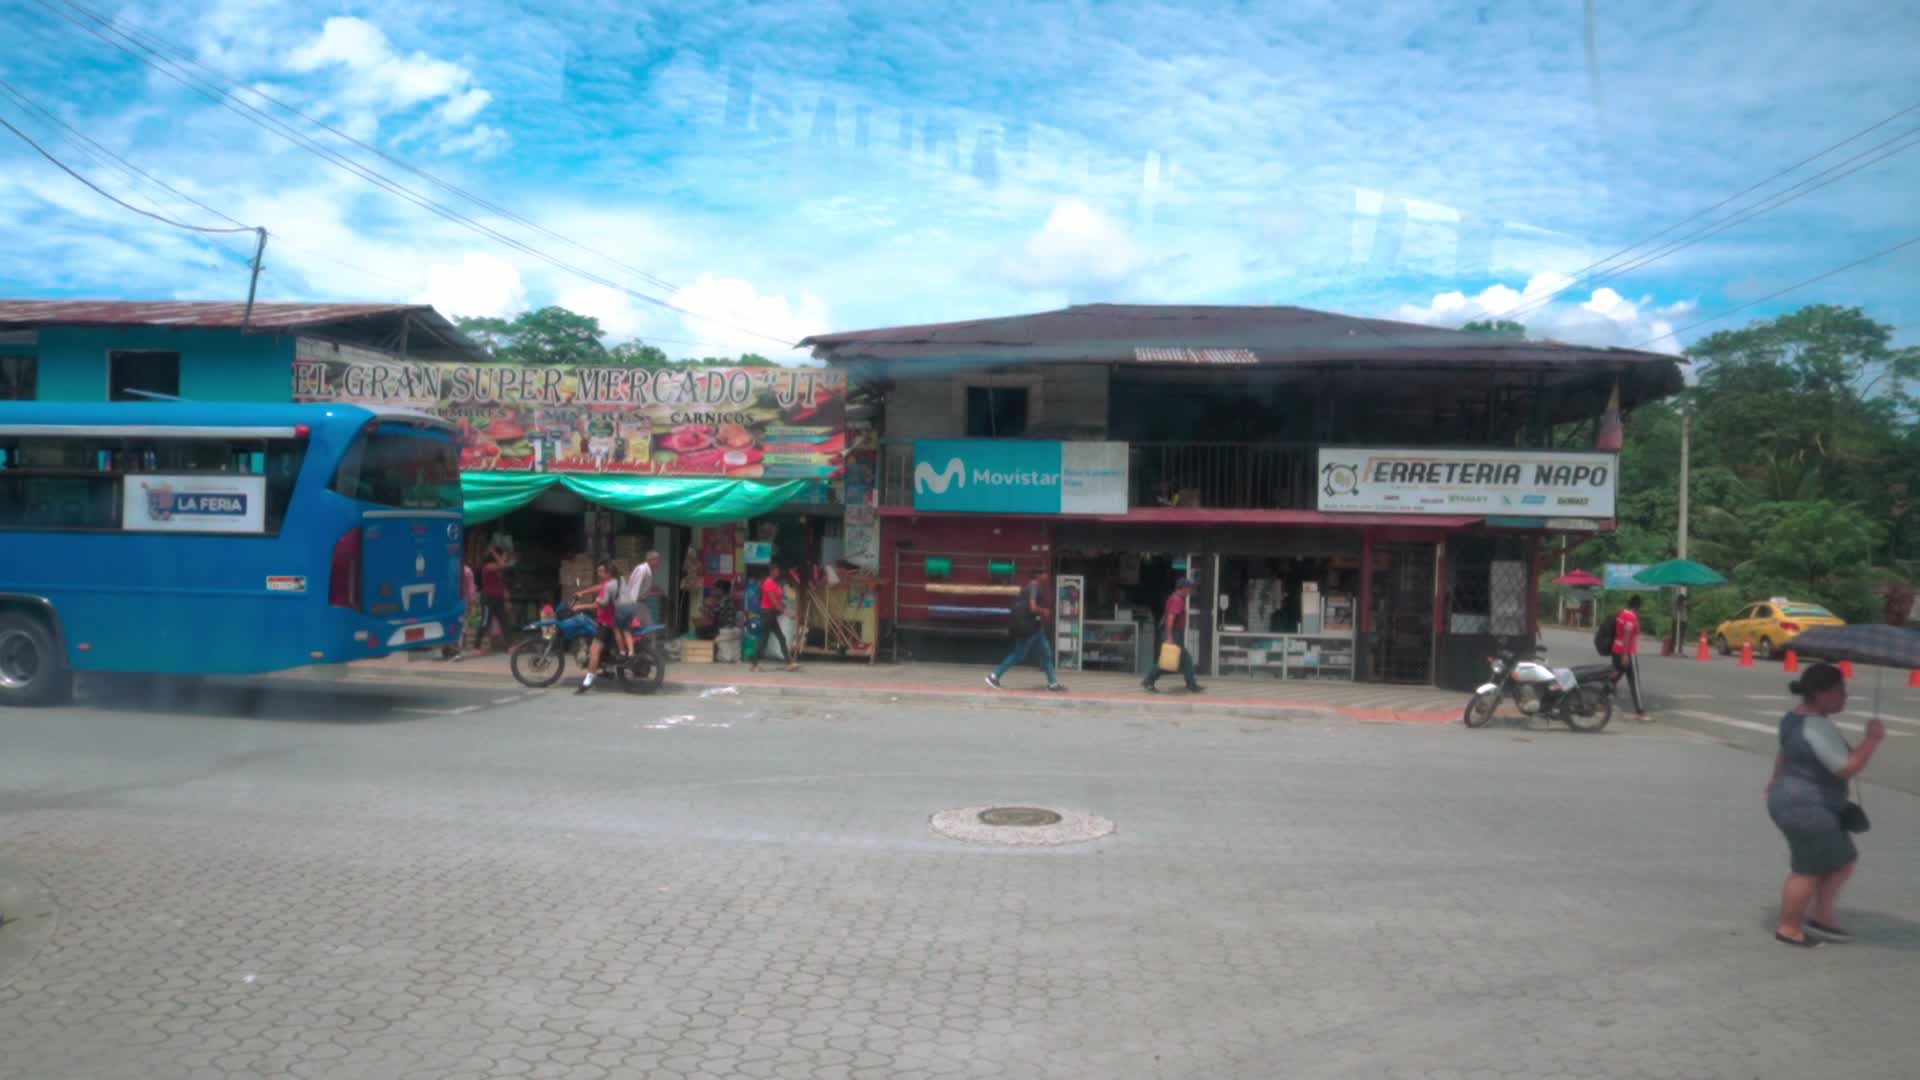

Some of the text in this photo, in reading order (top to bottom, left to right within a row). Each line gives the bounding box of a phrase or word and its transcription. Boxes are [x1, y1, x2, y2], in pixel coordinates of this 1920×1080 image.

[294, 363, 336, 397] EL
[343, 364, 443, 399] GRAN
[450, 366, 563, 405] SUPER
[573, 367, 753, 407] MERCADO
[670, 411, 755, 425] CARNICOS
[972, 468, 1059, 486] Movistar
[1533, 464, 1608, 487] NAPO
[177, 498, 242, 512] LA FERIA
